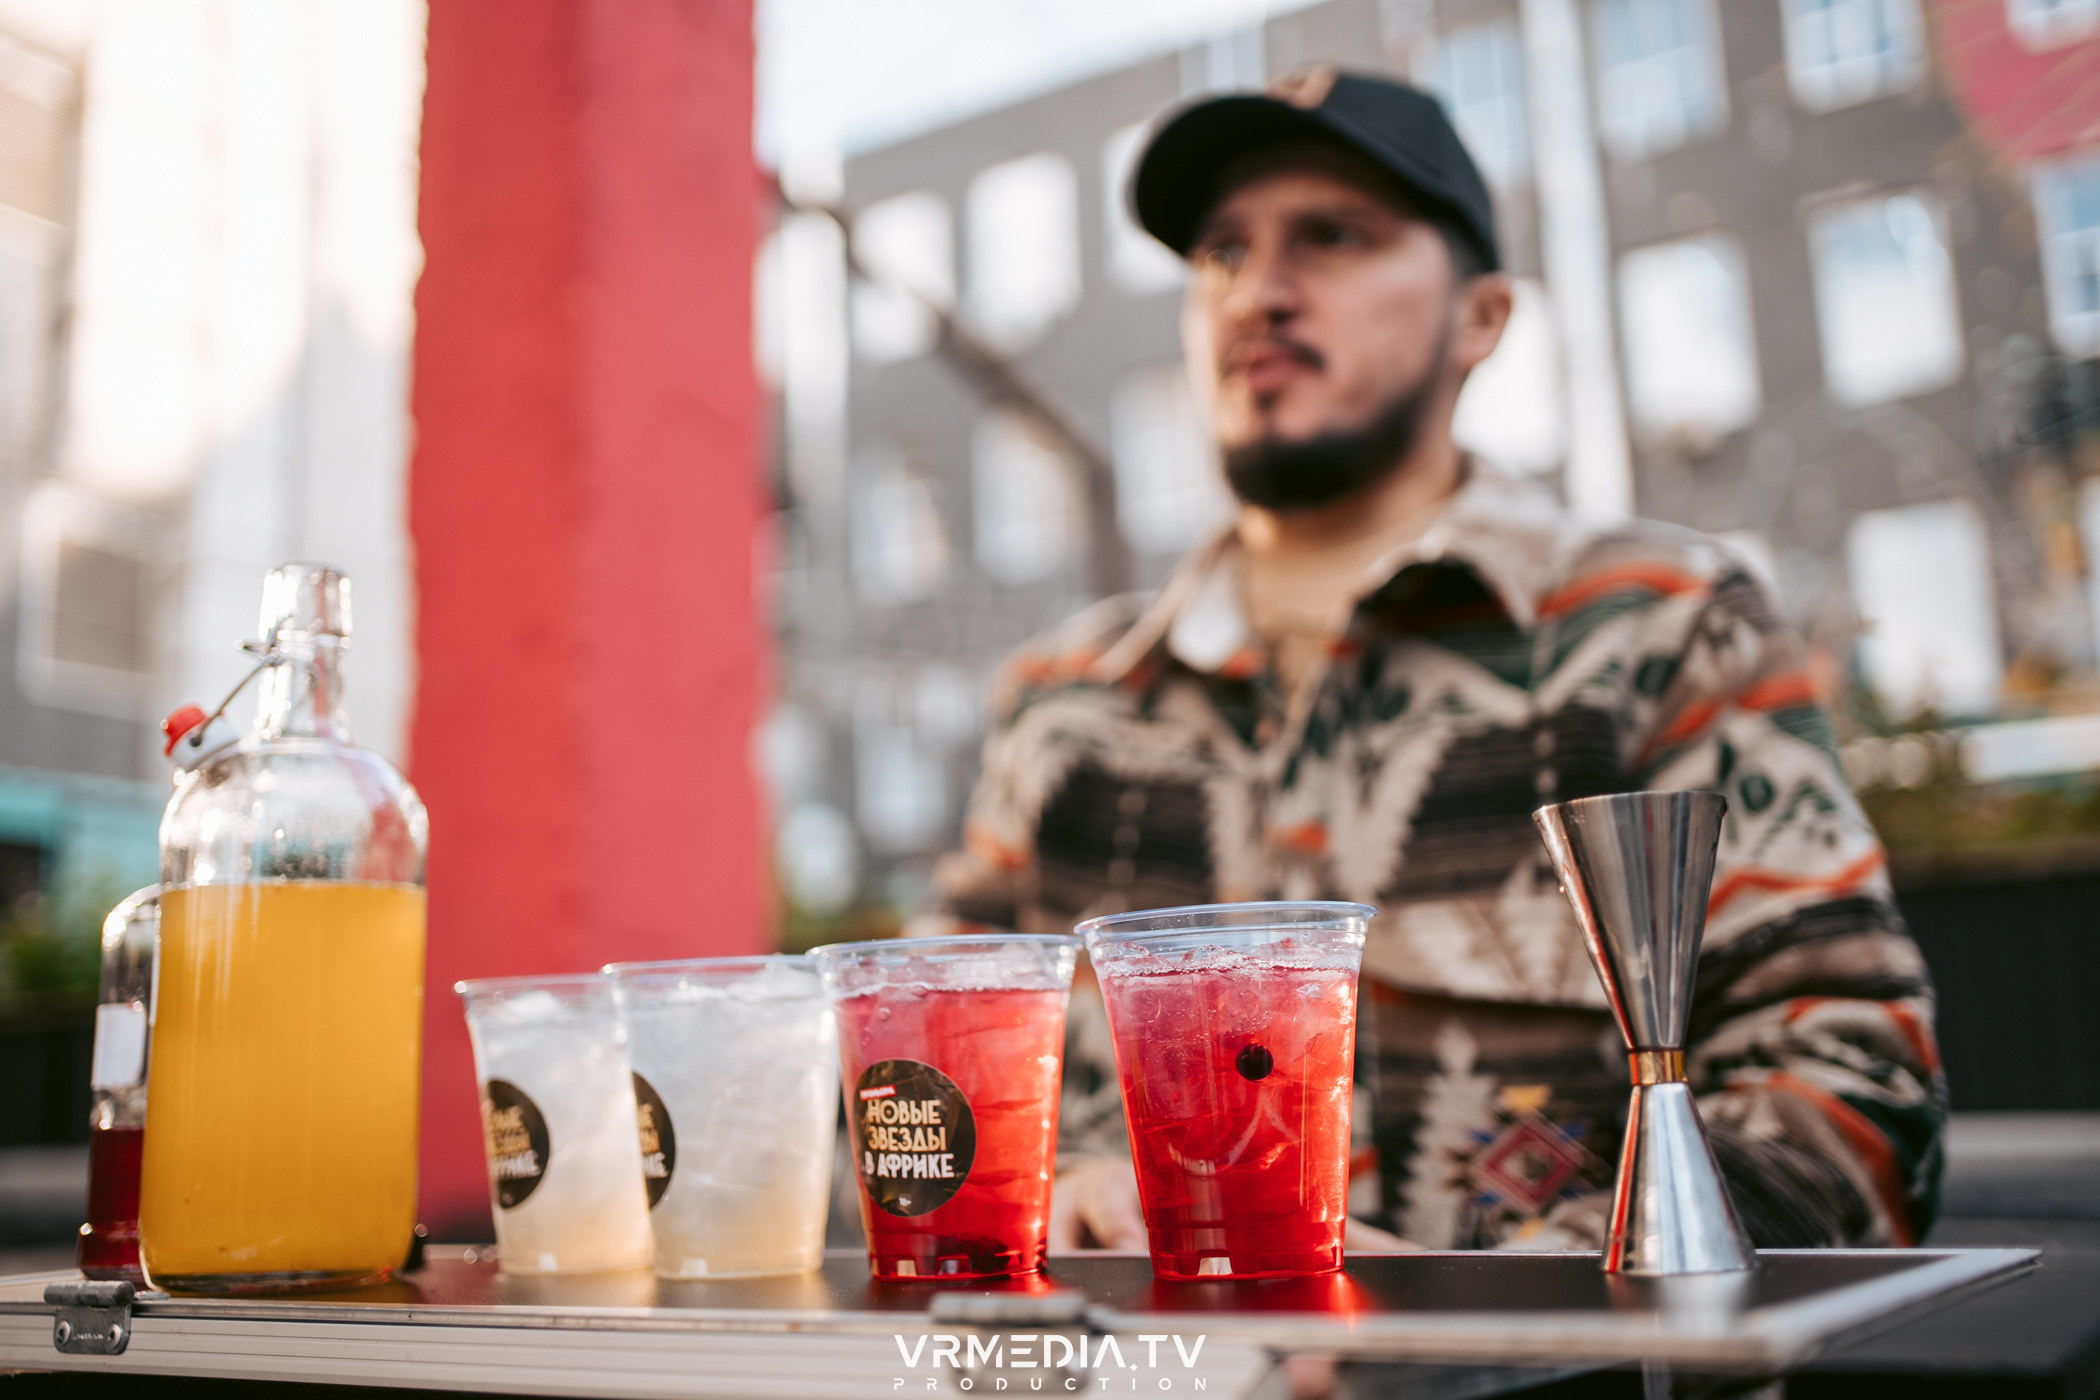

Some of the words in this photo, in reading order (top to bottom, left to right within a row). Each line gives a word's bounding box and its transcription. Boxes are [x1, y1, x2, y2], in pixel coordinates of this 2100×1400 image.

[867, 1099, 942, 1125] НОВЫЕ
[867, 1125, 947, 1152] ЗВЕЗДЫ
[864, 1151, 875, 1176] В
[877, 1153, 955, 1179] АФРИКЕ
